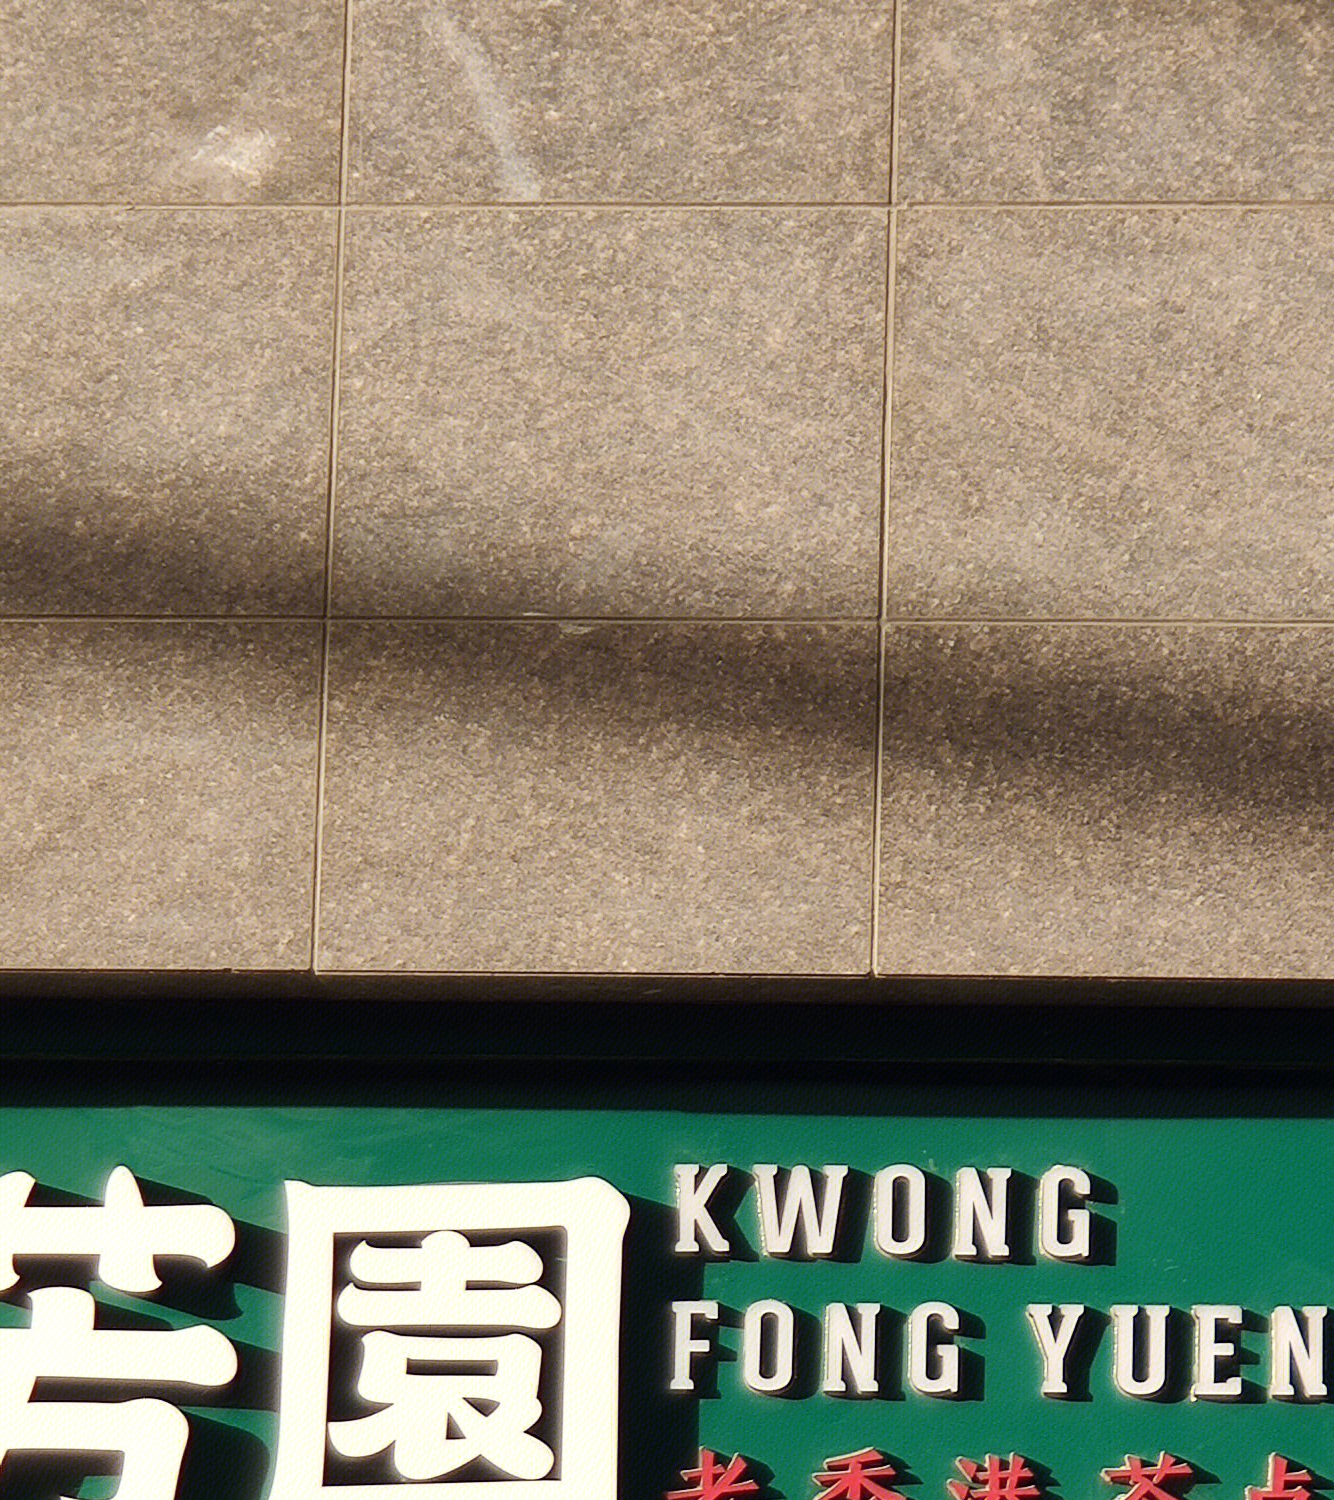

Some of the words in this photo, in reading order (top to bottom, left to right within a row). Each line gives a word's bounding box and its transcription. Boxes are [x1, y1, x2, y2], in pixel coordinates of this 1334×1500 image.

[674, 1163, 1092, 1259] KWONG
[669, 1299, 961, 1396] FONG
[1026, 1303, 1329, 1400] YUEN
